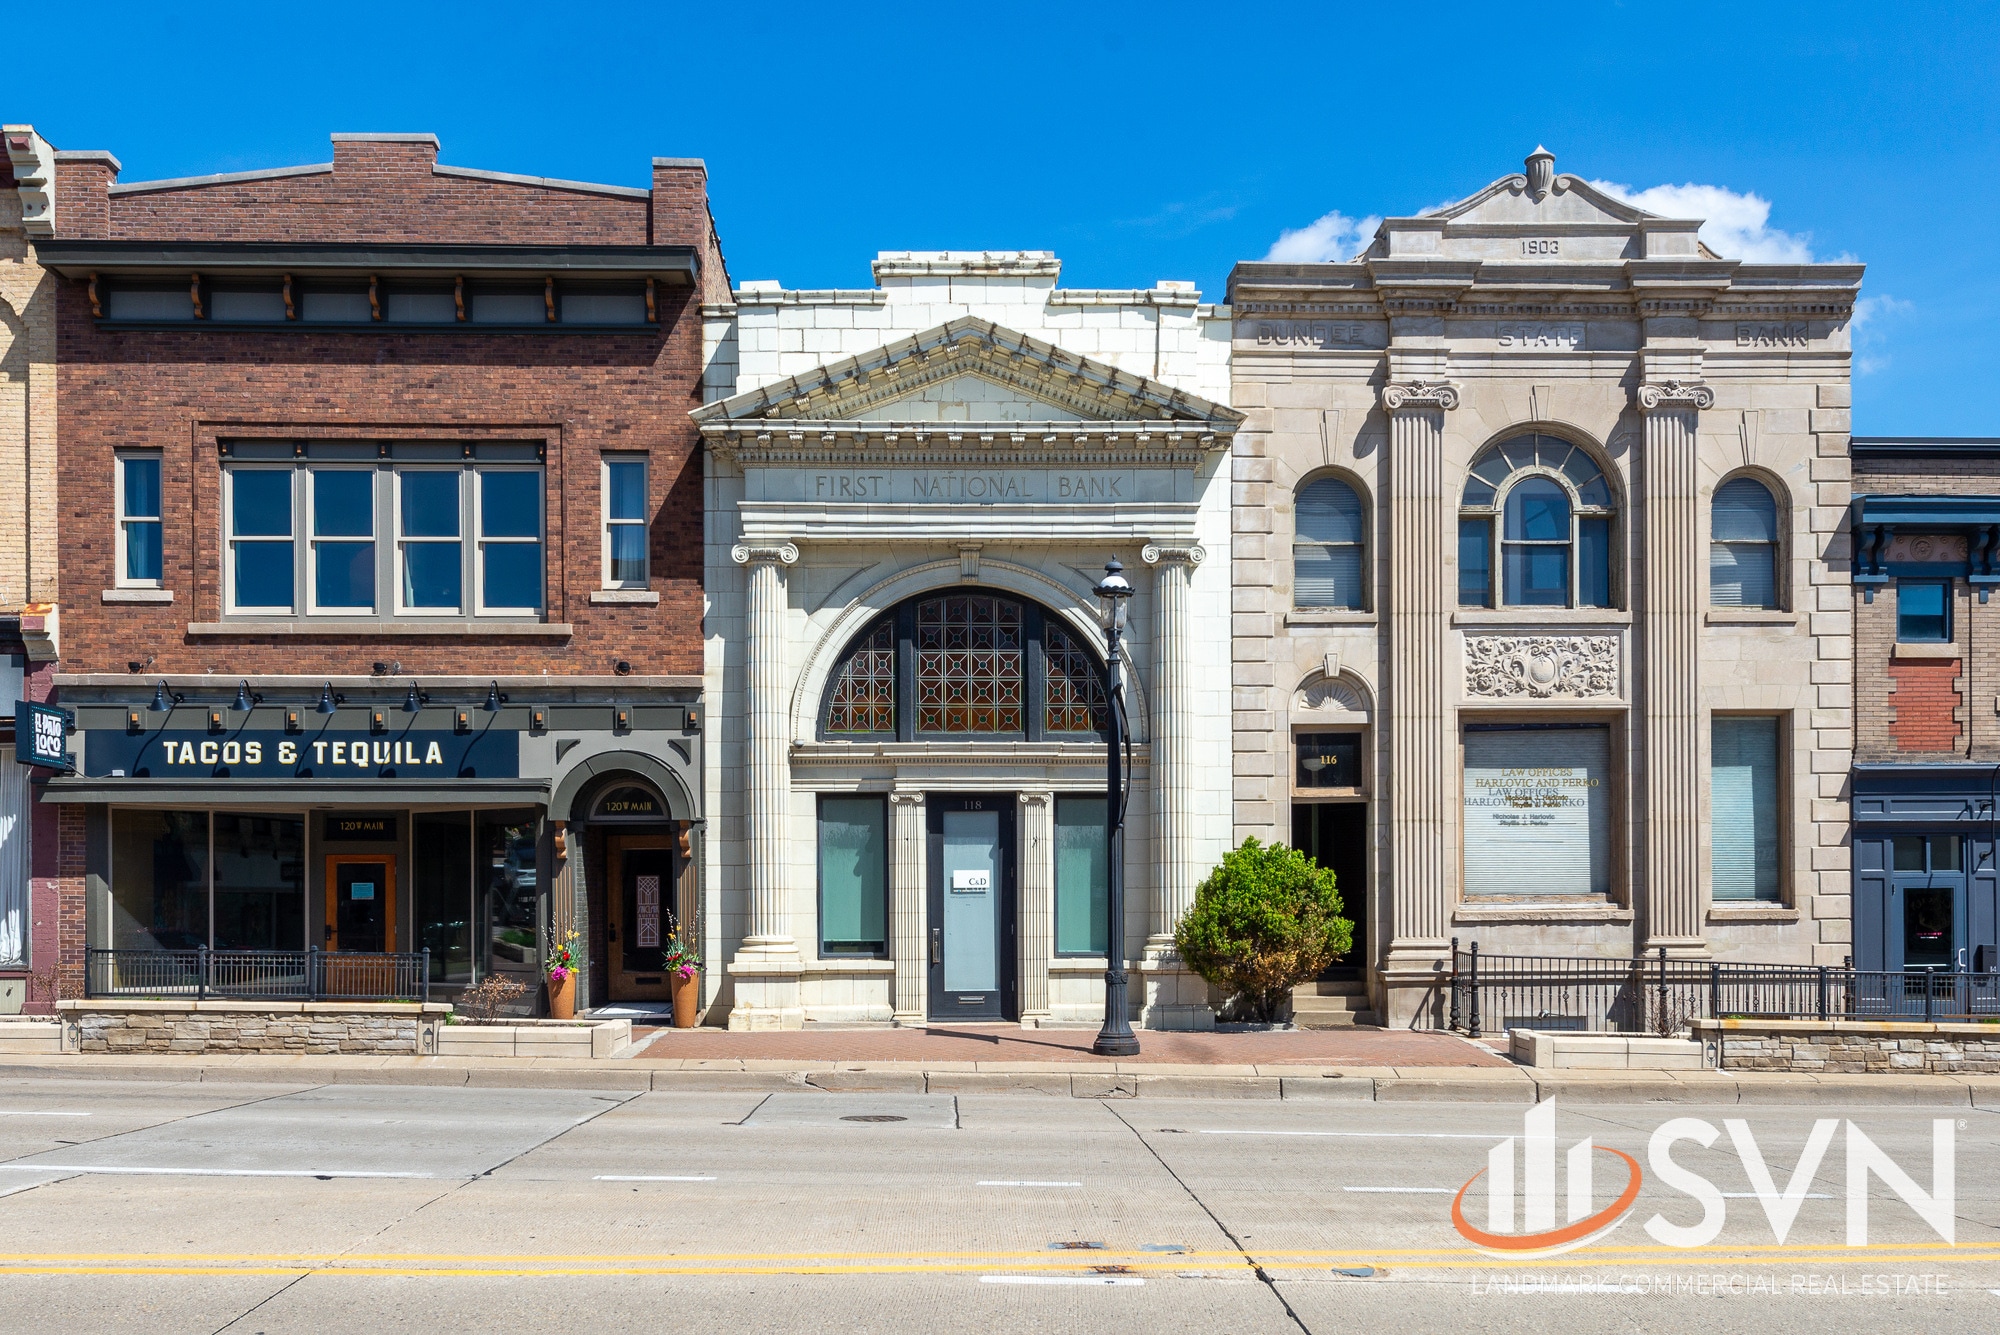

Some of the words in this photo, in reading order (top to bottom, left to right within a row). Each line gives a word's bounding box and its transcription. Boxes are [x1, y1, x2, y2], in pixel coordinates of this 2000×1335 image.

[1521, 240, 1559, 255] 1903
[1256, 323, 1366, 346] DUNDEE
[1498, 325, 1585, 347] STATE
[1736, 325, 1809, 347] BANK
[815, 475, 884, 497] FIRST
[912, 474, 1034, 497] NATIONAL
[1058, 475, 1123, 497] BANK
[42, 714, 62, 737] PATO
[35, 733, 62, 758] LOCO
[163, 741, 262, 764] TACOS
[278, 741, 298, 764] &
[313, 741, 443, 768] TEQUILA
[1320, 755, 1337, 765] 116
[1501, 768, 1525, 777] LAW
[1528, 768, 1573, 777] OFFICES
[1475, 779, 1534, 788] HARLOVIC
[1536, 779, 1560, 788] AND
[1562, 778, 1600, 788] PERKO
[630, 801, 652, 811] MAIN
[964, 800, 982, 810] 118
[363, 821, 384, 831] MAIN
[968, 877, 987, 886] C&D
